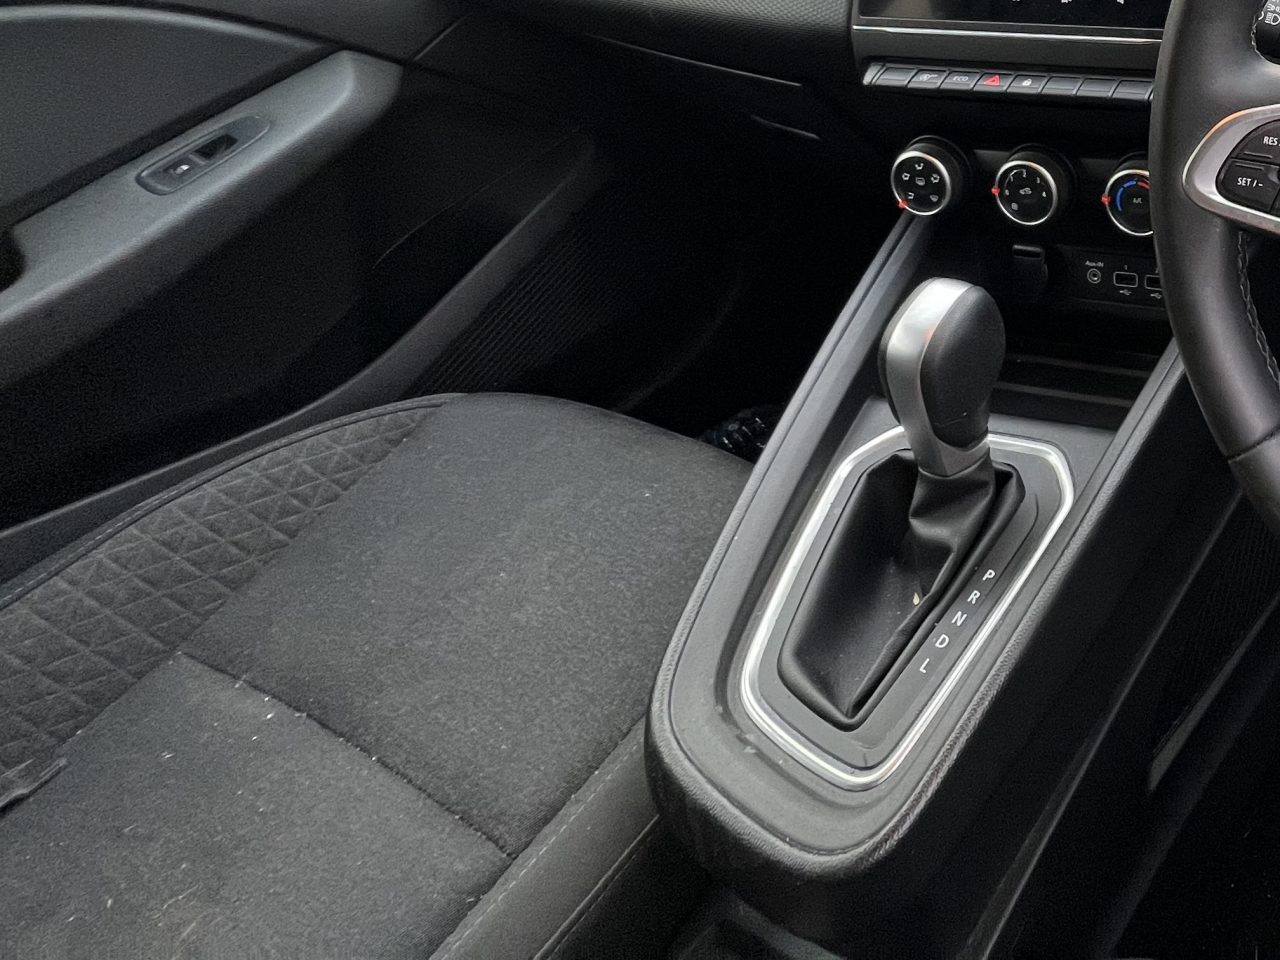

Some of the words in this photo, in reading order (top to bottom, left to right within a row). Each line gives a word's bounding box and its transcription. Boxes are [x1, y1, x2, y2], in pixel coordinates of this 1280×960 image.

[1263, 136, 1278, 146] RES
[1237, 177, 1251, 188] SET
[982, 569, 996, 581] P
[967, 590, 981, 604] R
[951, 611, 967, 626] N
[935, 633, 949, 648] D
[919, 658, 930, 673] L
